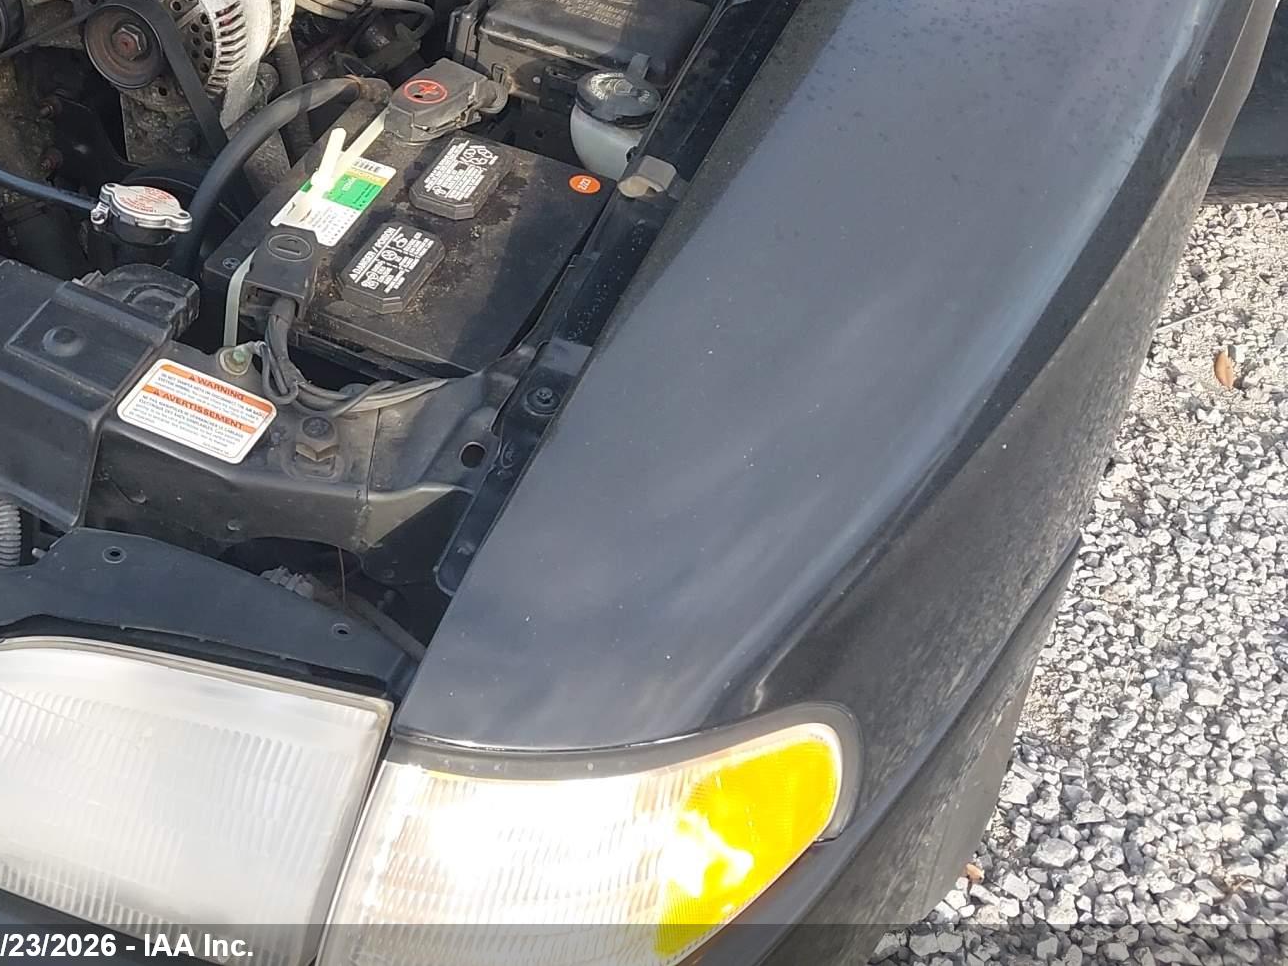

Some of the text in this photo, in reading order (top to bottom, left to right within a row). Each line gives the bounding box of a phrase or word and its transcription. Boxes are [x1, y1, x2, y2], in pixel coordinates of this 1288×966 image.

[352, 250, 376, 276] DANGER
[374, 226, 397, 249] POISON
[196, 376, 245, 401] WARNING
[162, 392, 245, 431] AVERTISSEMENT
